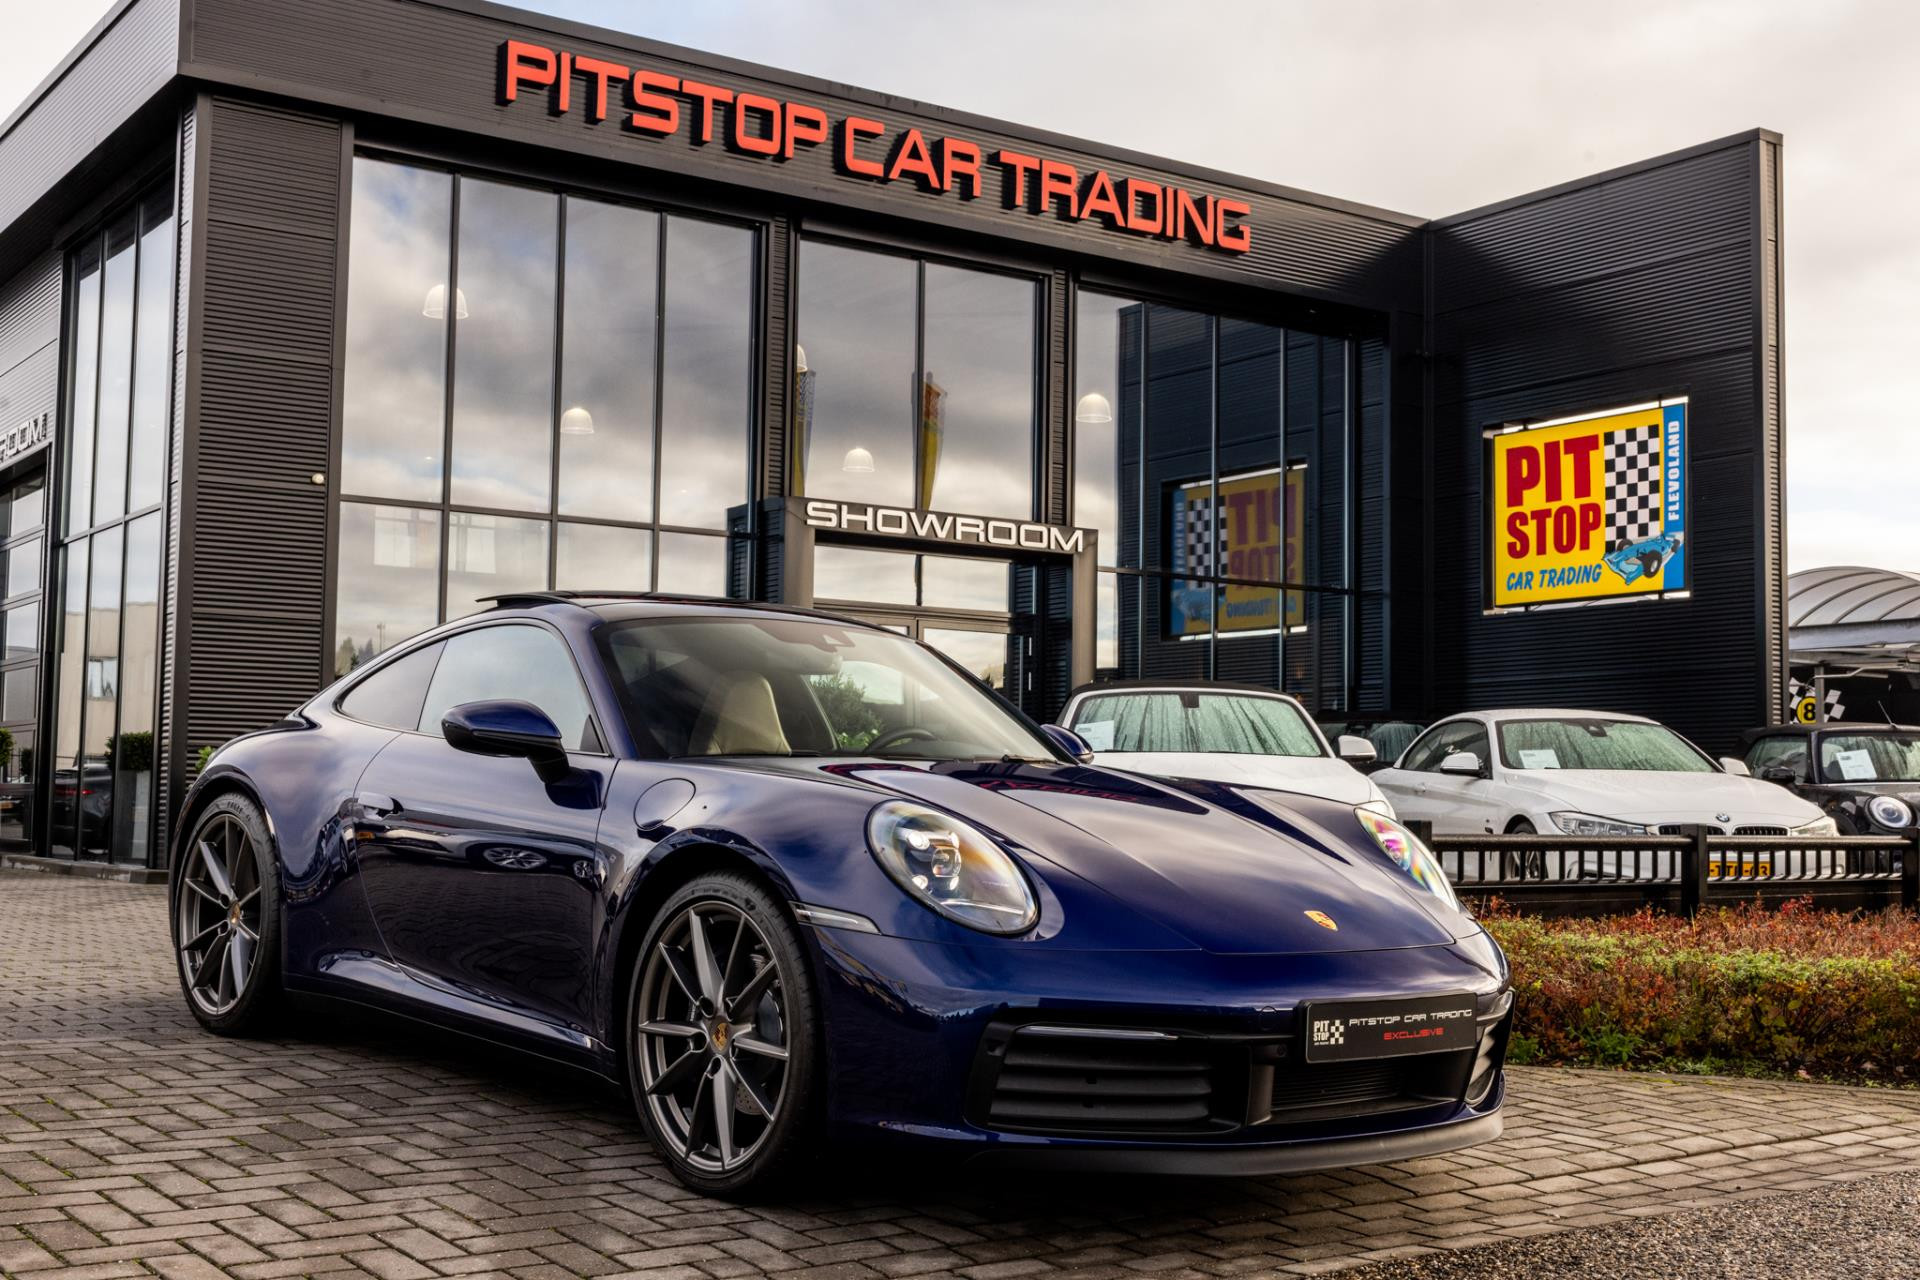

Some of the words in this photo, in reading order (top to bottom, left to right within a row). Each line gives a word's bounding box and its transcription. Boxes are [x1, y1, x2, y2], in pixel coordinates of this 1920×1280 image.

[505, 40, 828, 159] PITSTOP
[846, 117, 981, 197] CAR
[1000, 150, 1250, 252] TRADING
[1506, 434, 1599, 508] PIT
[1667, 420, 1681, 521] FLEVOLAND
[806, 501, 1083, 553] SHOWROOM
[1507, 502, 1602, 560] STOP
[1506, 571, 1534, 591] CAR
[1538, 564, 1602, 589] TRADING
[1803, 702, 1816, 721] 8
[1313, 1020, 1330, 1033] PIT
[1349, 1016, 1401, 1027] PITSTOP
[1404, 1013, 1427, 1023] CAR
[1430, 1009, 1472, 1020] TRADING
[1313, 1031, 1330, 1042] STOP
[1383, 1027, 1444, 1040] EXCLUSIVE
